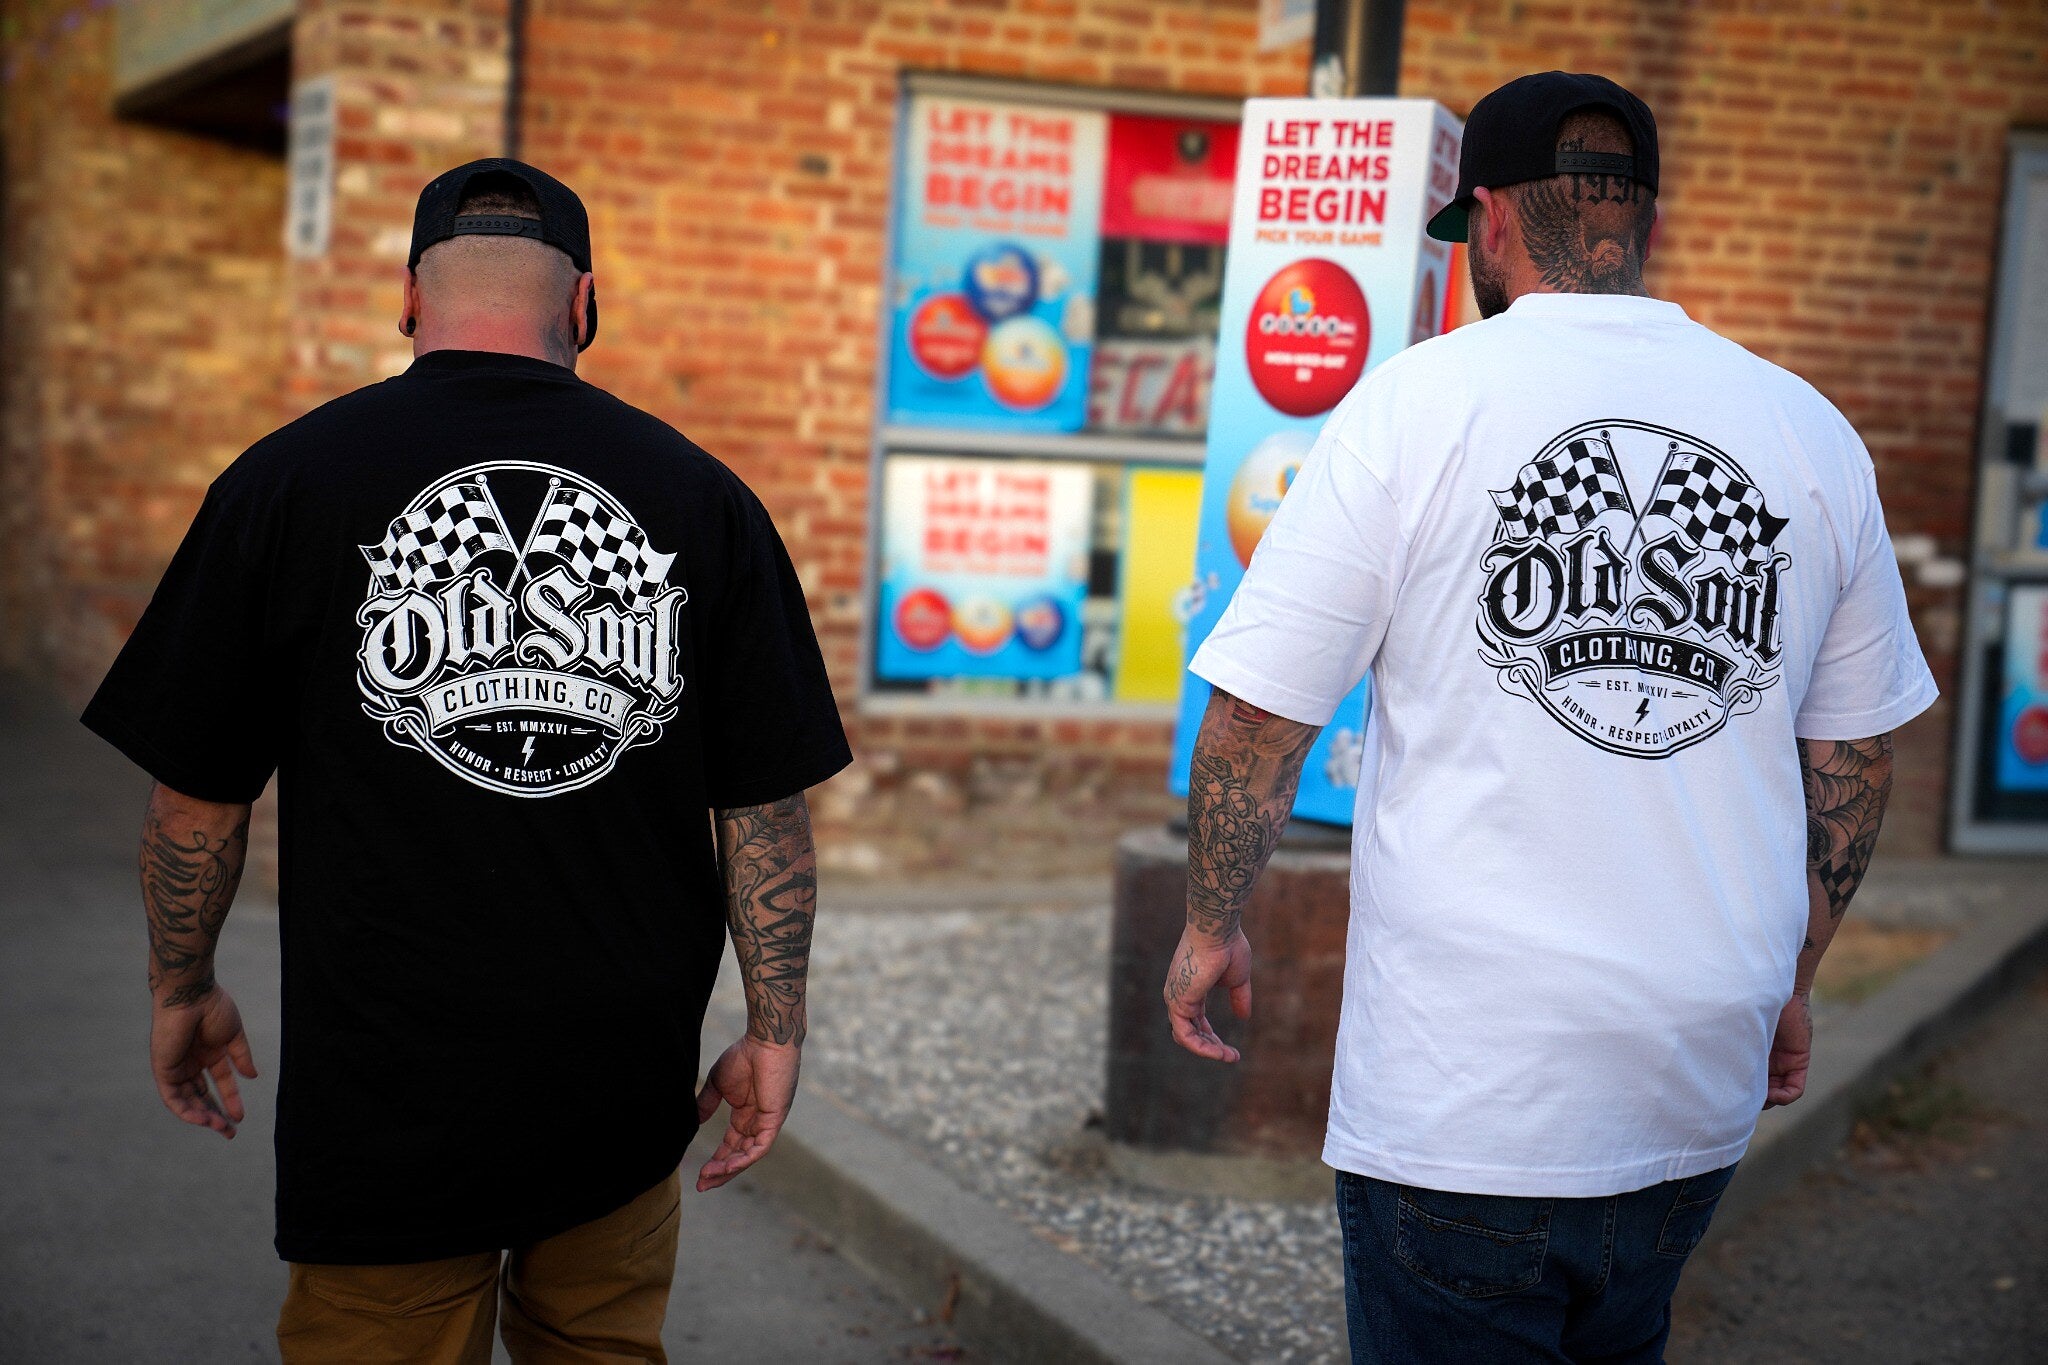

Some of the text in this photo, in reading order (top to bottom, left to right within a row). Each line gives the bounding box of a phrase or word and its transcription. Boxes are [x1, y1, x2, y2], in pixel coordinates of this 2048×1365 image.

[1266, 121, 1394, 148] LET THE
[1263, 154, 1389, 181] DREAMS
[1258, 187, 1388, 225] BEGIN
[1256, 229, 1383, 246] PICK YOUR GAME
[1481, 528, 1789, 667] Old Soul
[359, 567, 686, 701] Old Soul
[1559, 636, 1718, 686] CLOTHNG, CO.
[443, 677, 616, 719] CLOTHING, CO.
[1606, 679, 1632, 692] EST.
[496, 720, 568, 735] EST. MMXXVI
[1561, 695, 1598, 730] HONOR
[1664, 708, 1711, 741] LOYALTY
[448, 740, 610, 783] HONOR RESPECT LOYALTY
